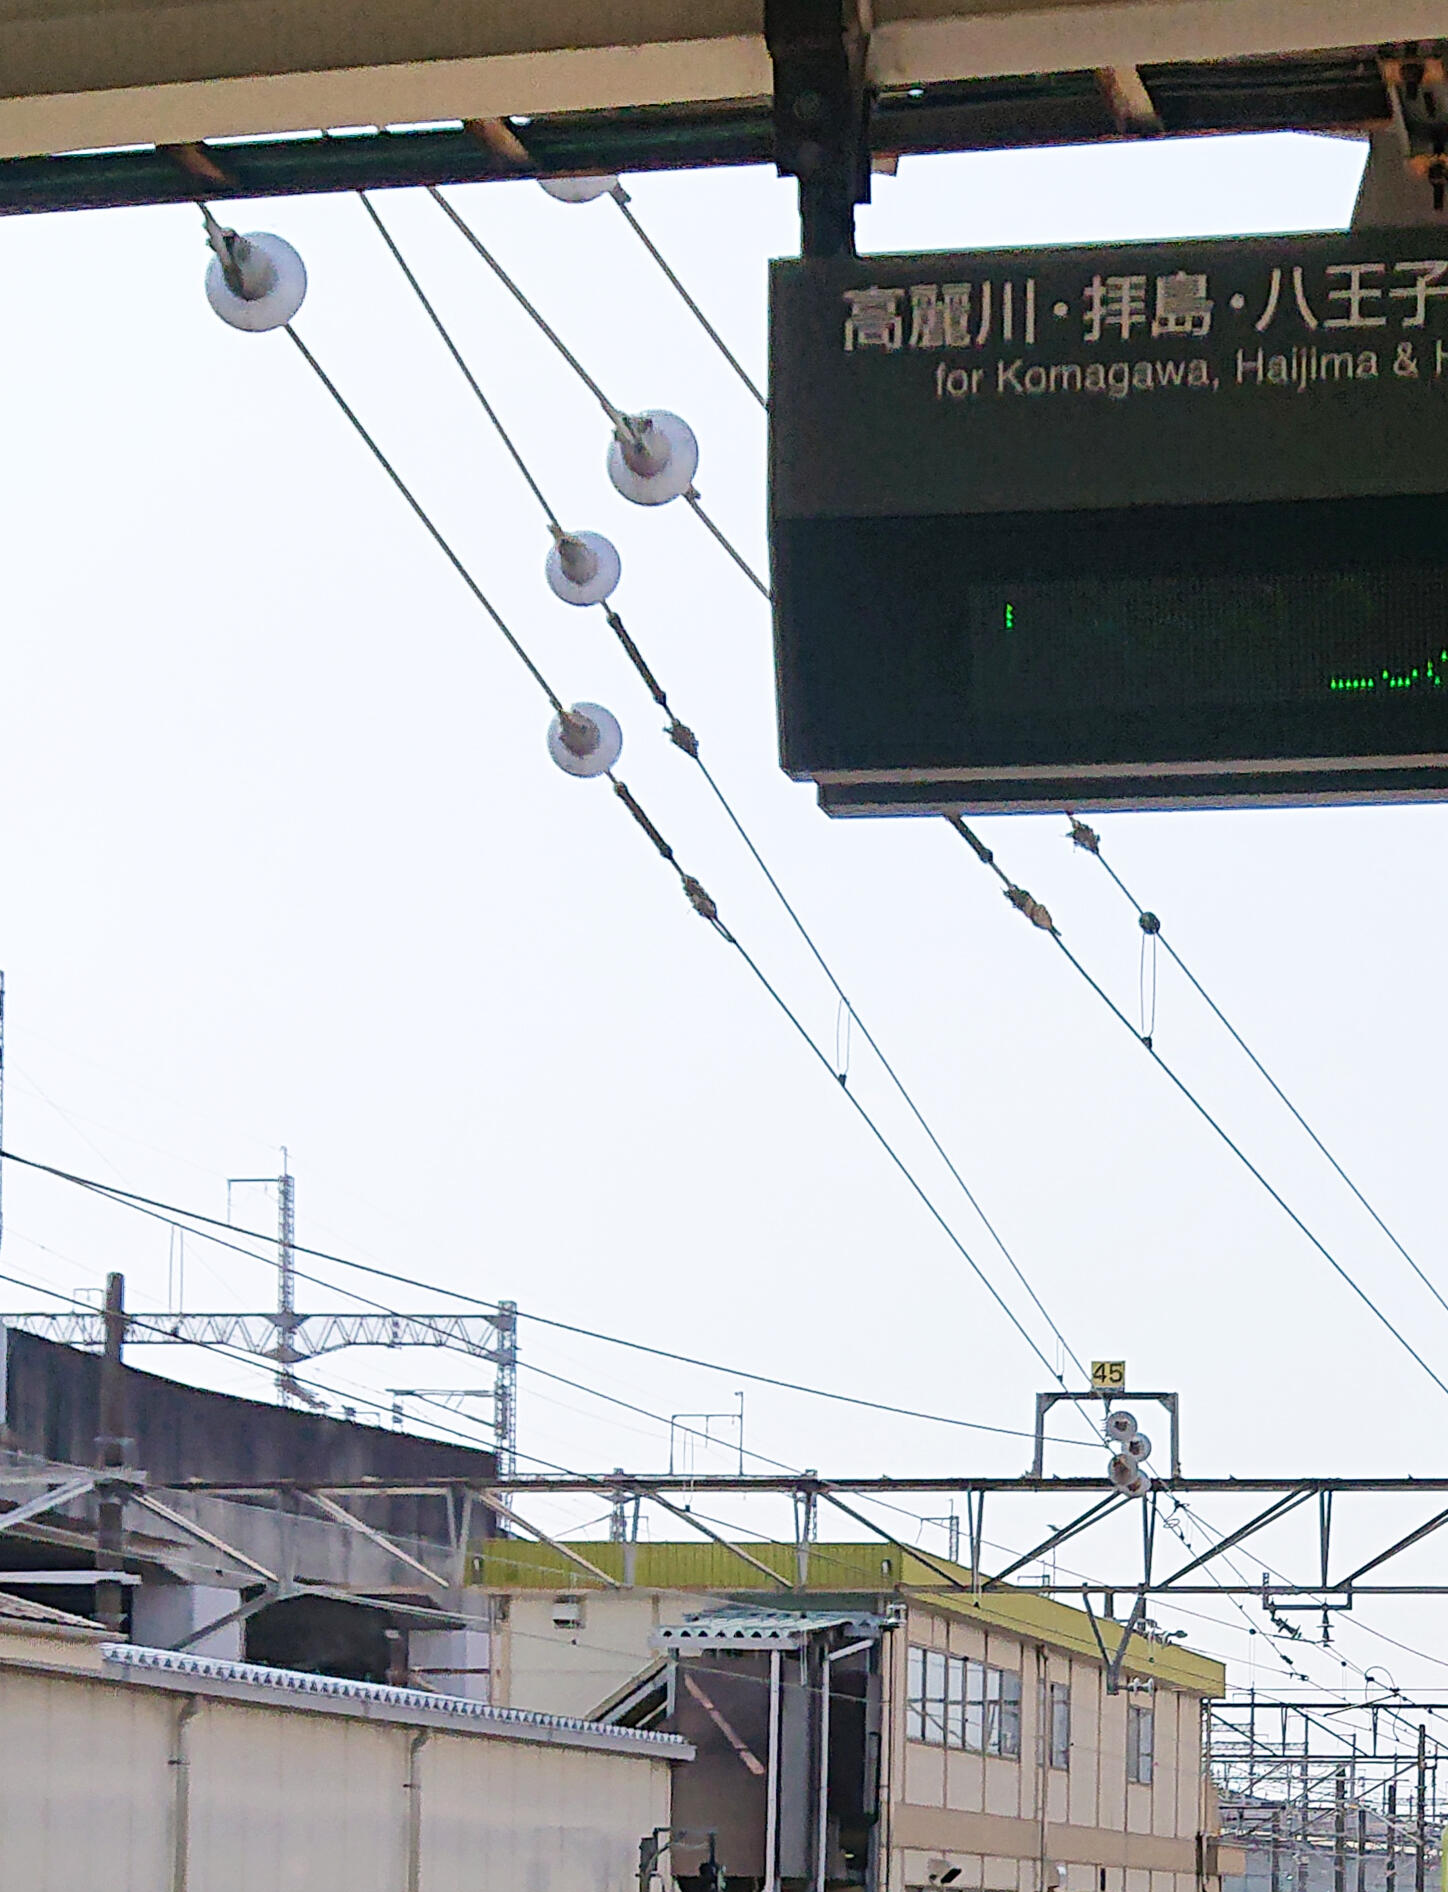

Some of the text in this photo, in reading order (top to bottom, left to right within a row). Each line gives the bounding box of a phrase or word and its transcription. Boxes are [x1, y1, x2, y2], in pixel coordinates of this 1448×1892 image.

[936, 360, 983, 398] for
[997, 357, 1220, 398] Komagawa,
[1235, 344, 1379, 394] Haijima
[1393, 340, 1420, 380] &
[1093, 1363, 1123, 1383] 45
